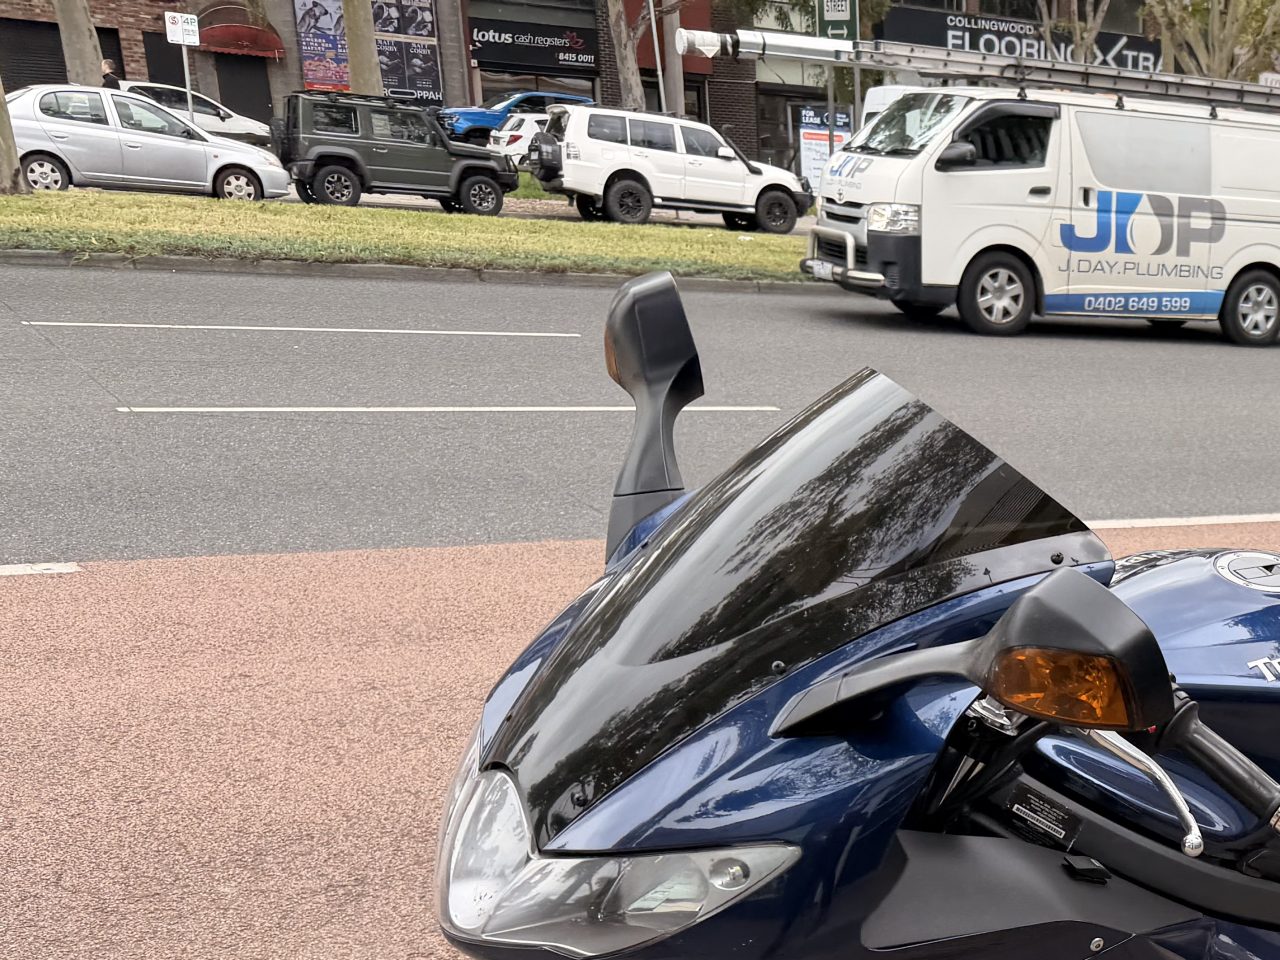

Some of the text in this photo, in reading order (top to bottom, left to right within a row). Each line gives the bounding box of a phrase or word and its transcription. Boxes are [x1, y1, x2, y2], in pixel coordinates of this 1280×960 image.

[826, 0, 848, 13] STREET
[183, 17, 197, 26] 4P
[946, 15, 1035, 35] COLLINGWOOD
[472, 28, 570, 47] lotus cash registers
[558, 52, 595, 63] 8415 0011
[802, 116, 821, 125] LEASE
[1084, 297, 1191, 312] 0402 649 599
